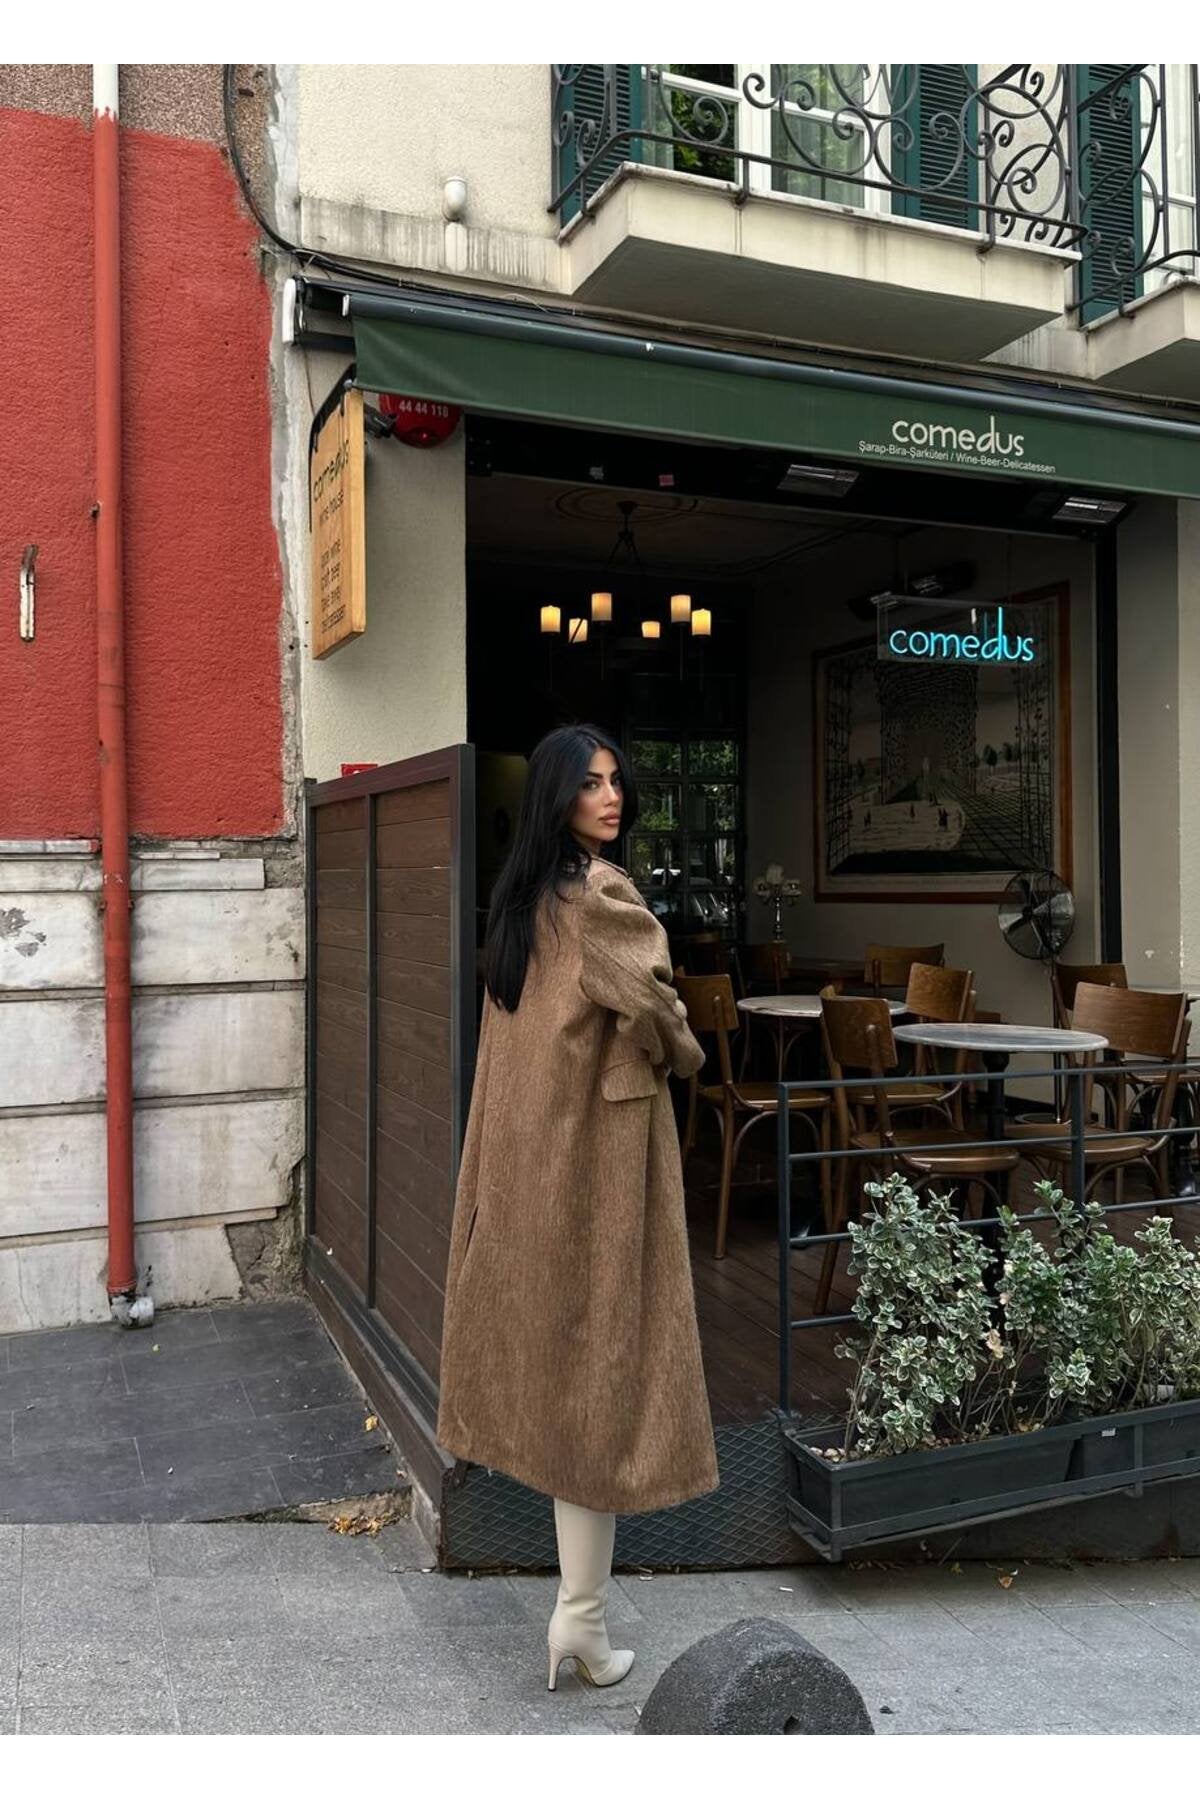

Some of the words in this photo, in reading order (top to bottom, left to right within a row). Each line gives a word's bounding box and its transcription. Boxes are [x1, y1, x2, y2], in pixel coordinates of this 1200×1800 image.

[399, 400, 412, 412] 44
[415, 402, 428, 414] 44
[892, 415, 1024, 456] comedus
[956, 452, 1056, 473] Wine-Beer-Delicatessen
[889, 606, 1034, 661] comedus
